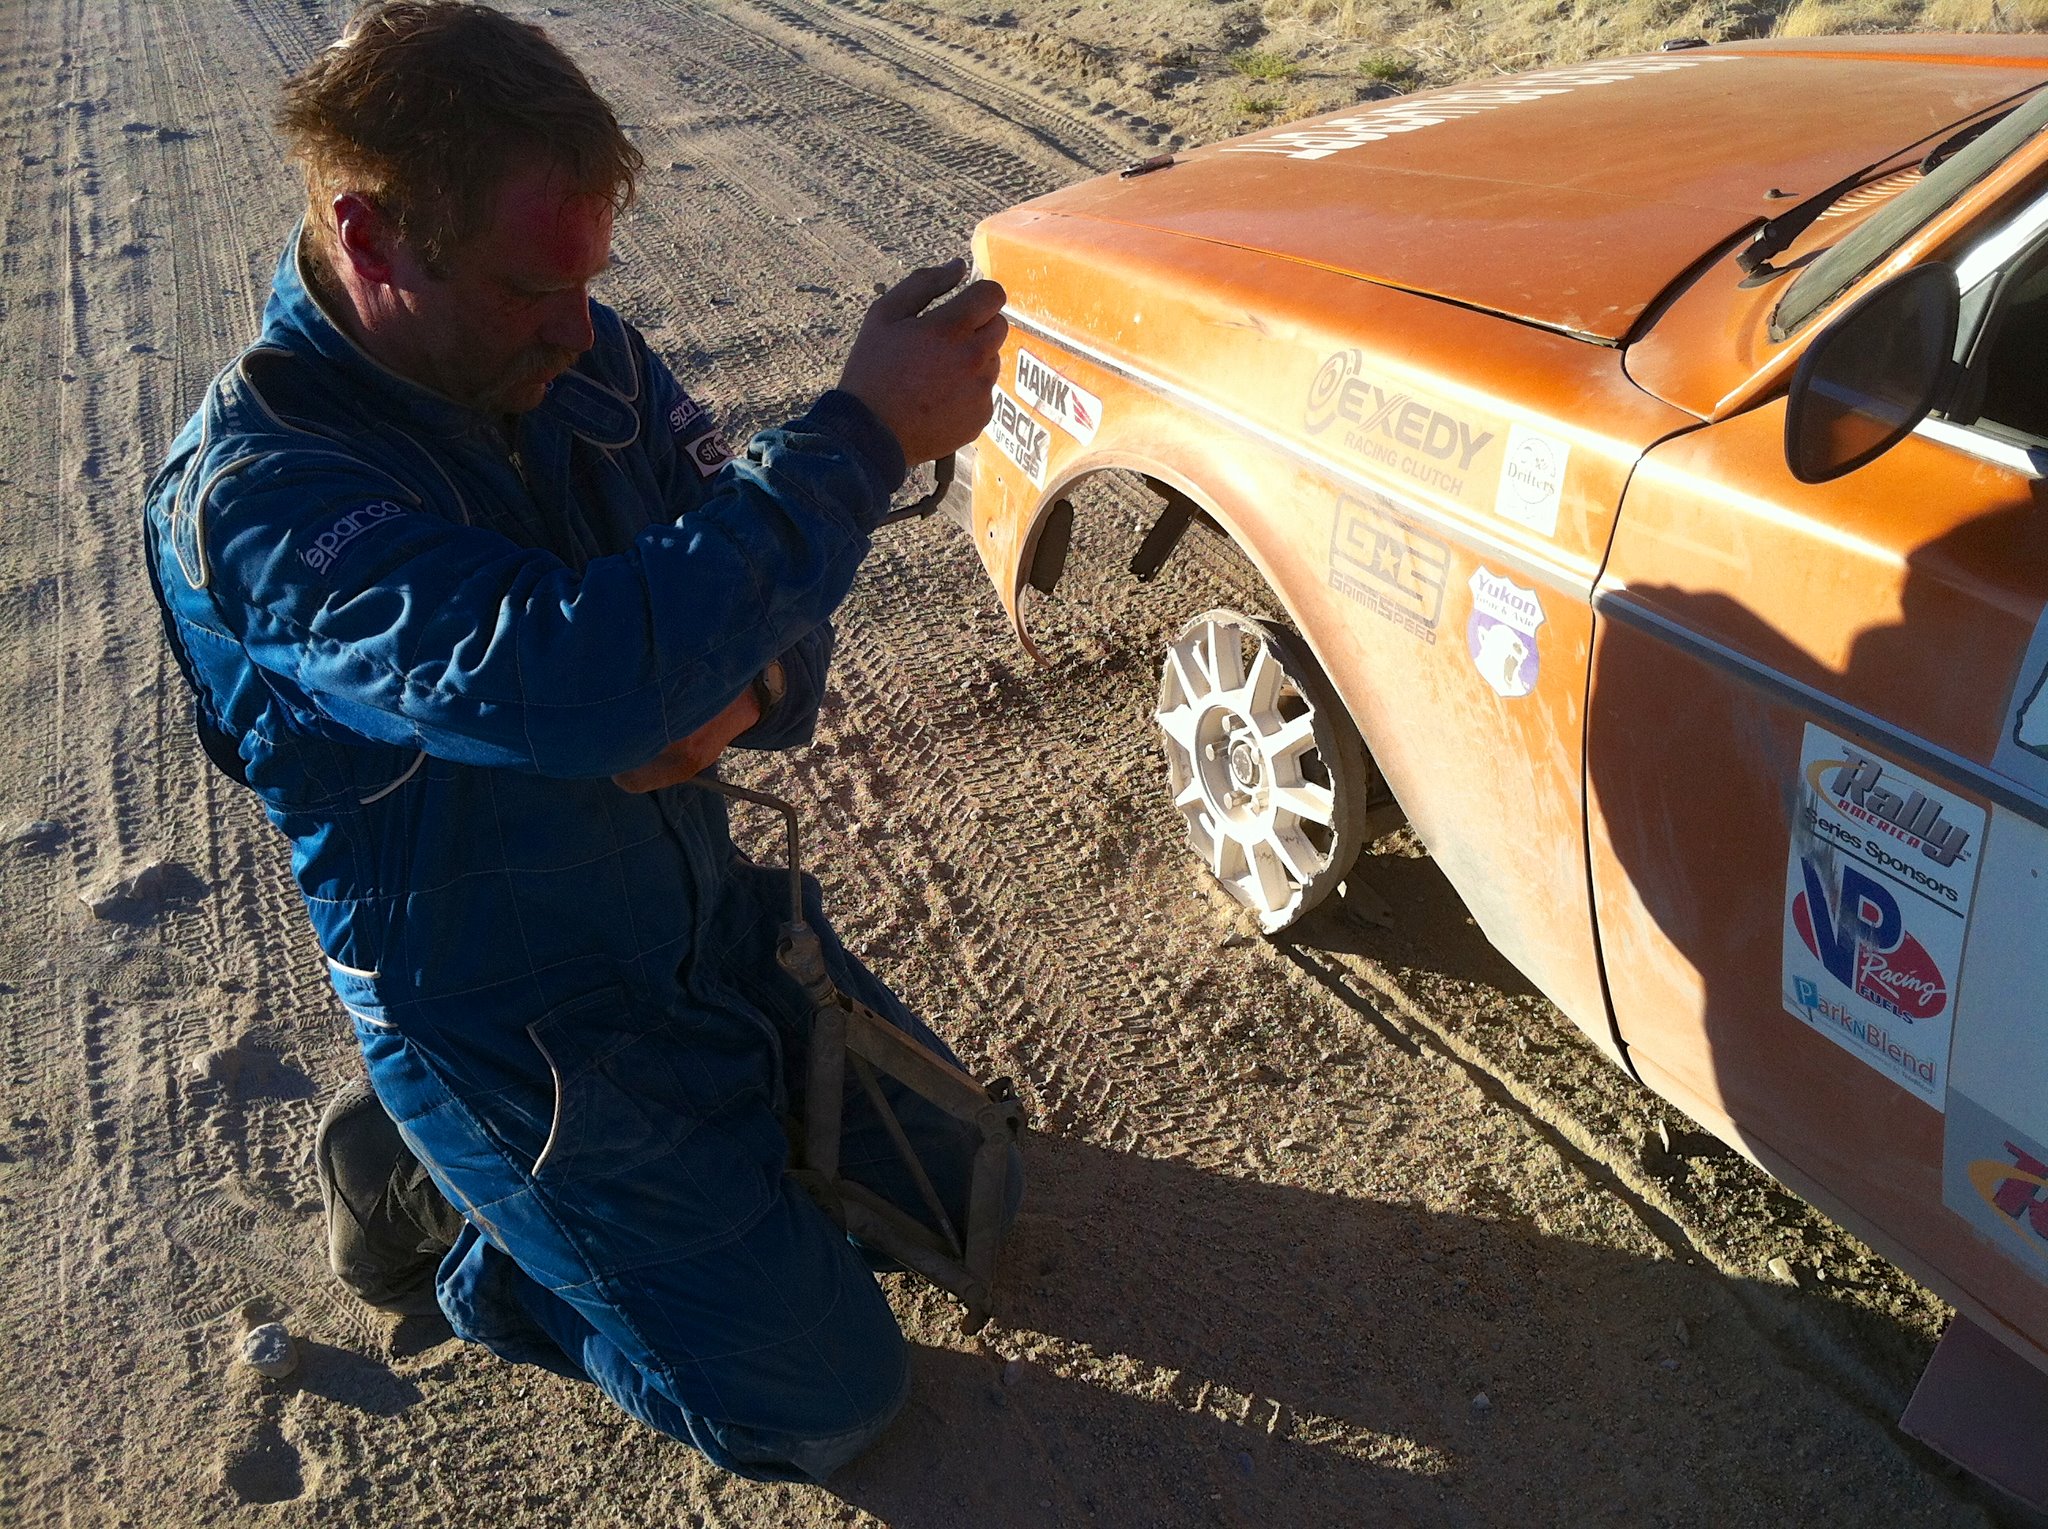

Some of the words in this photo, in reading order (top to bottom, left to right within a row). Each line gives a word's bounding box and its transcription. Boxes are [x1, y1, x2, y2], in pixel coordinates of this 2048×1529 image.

[1219, 88, 1575, 161] RALLYSPORT
[1017, 355, 1070, 416] HAWK
[1337, 378, 1494, 471] EXEDY
[1344, 431, 1398, 468] RACING
[1402, 456, 1464, 497] CLUTCH
[305, 501, 401, 570] sparco
[1479, 573, 1537, 617] Yukon
[1830, 745, 1970, 868] Rally
[1837, 799, 1921, 849] AMERICA
[1805, 807, 1862, 850] Series
[1864, 840, 1959, 903] Sponsors
[1801, 857, 1903, 991] VP
[1859, 986, 1914, 1025] FUELS
[1860, 952, 1946, 1006] Racing
